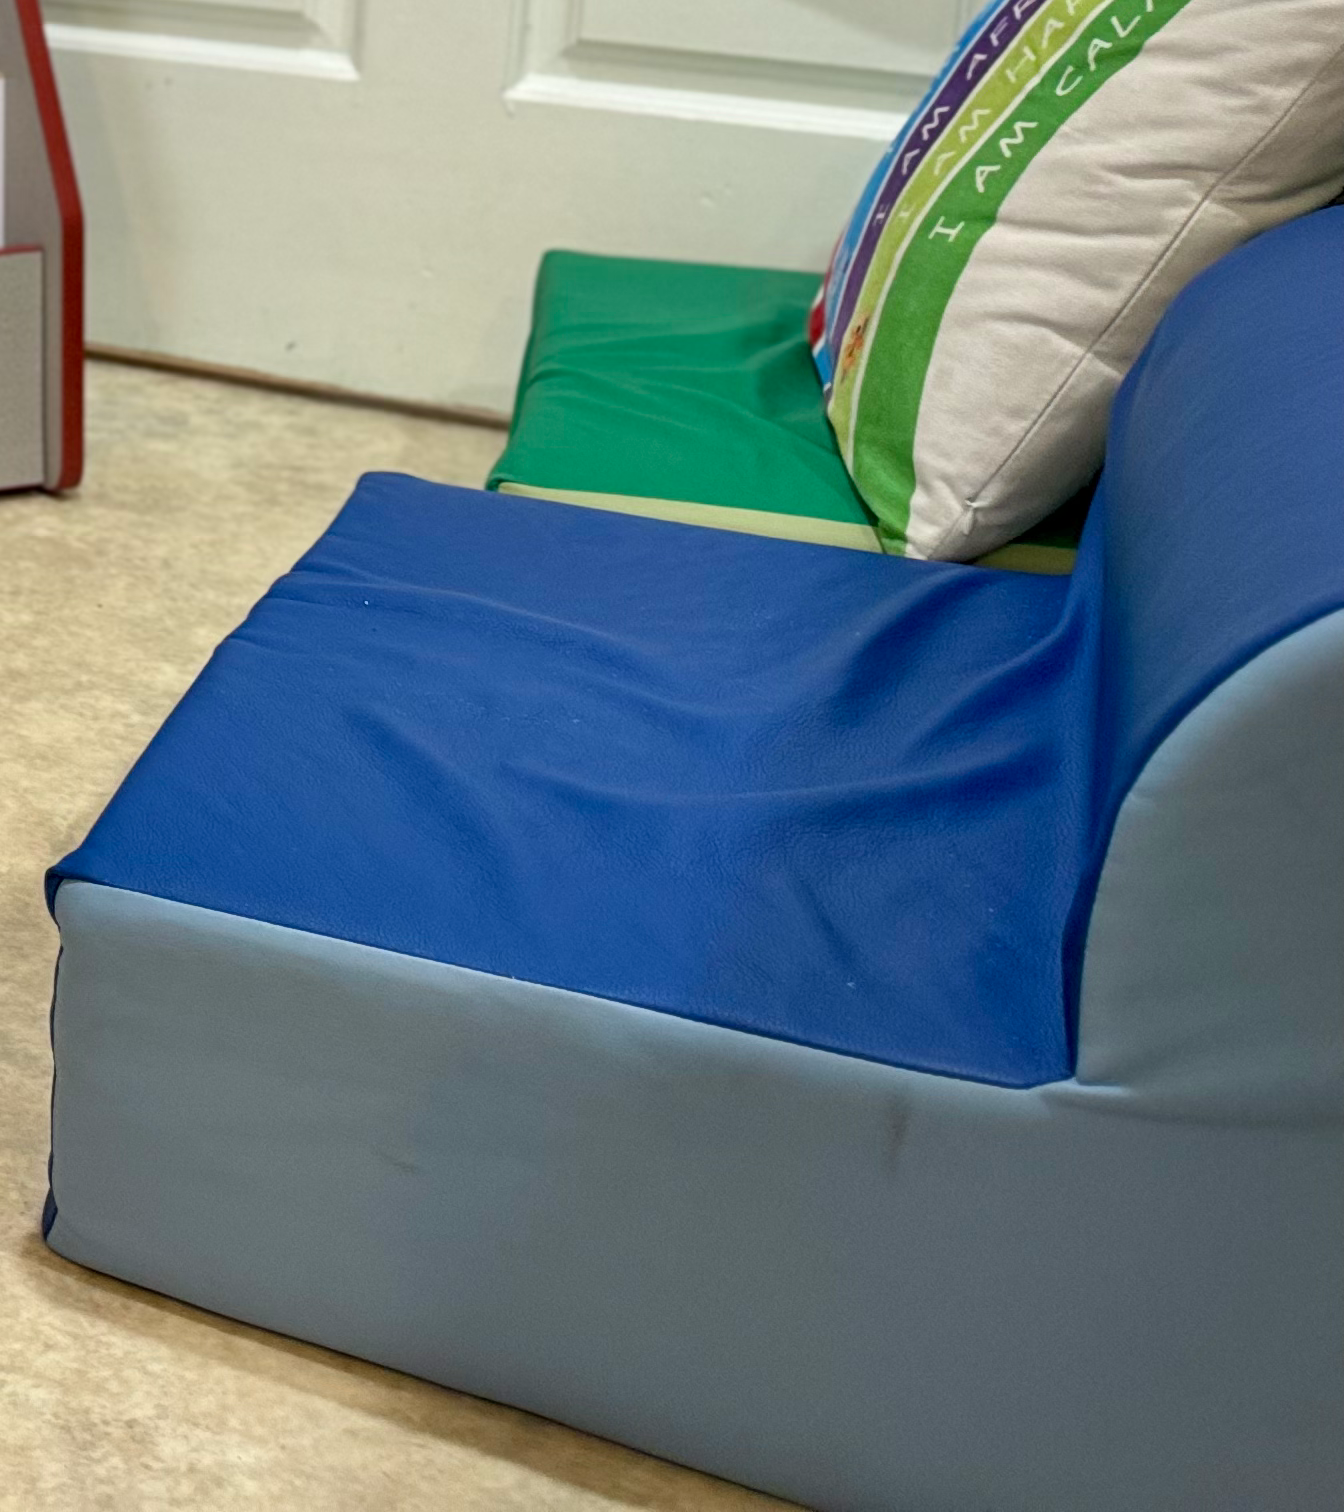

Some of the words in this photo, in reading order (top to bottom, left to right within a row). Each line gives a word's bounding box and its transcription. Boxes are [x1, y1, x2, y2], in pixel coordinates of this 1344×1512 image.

[902, 105, 951, 176] AM
[934, 108, 991, 176] AM
[929, 216, 965, 242] I
[975, 121, 1038, 192] AM
